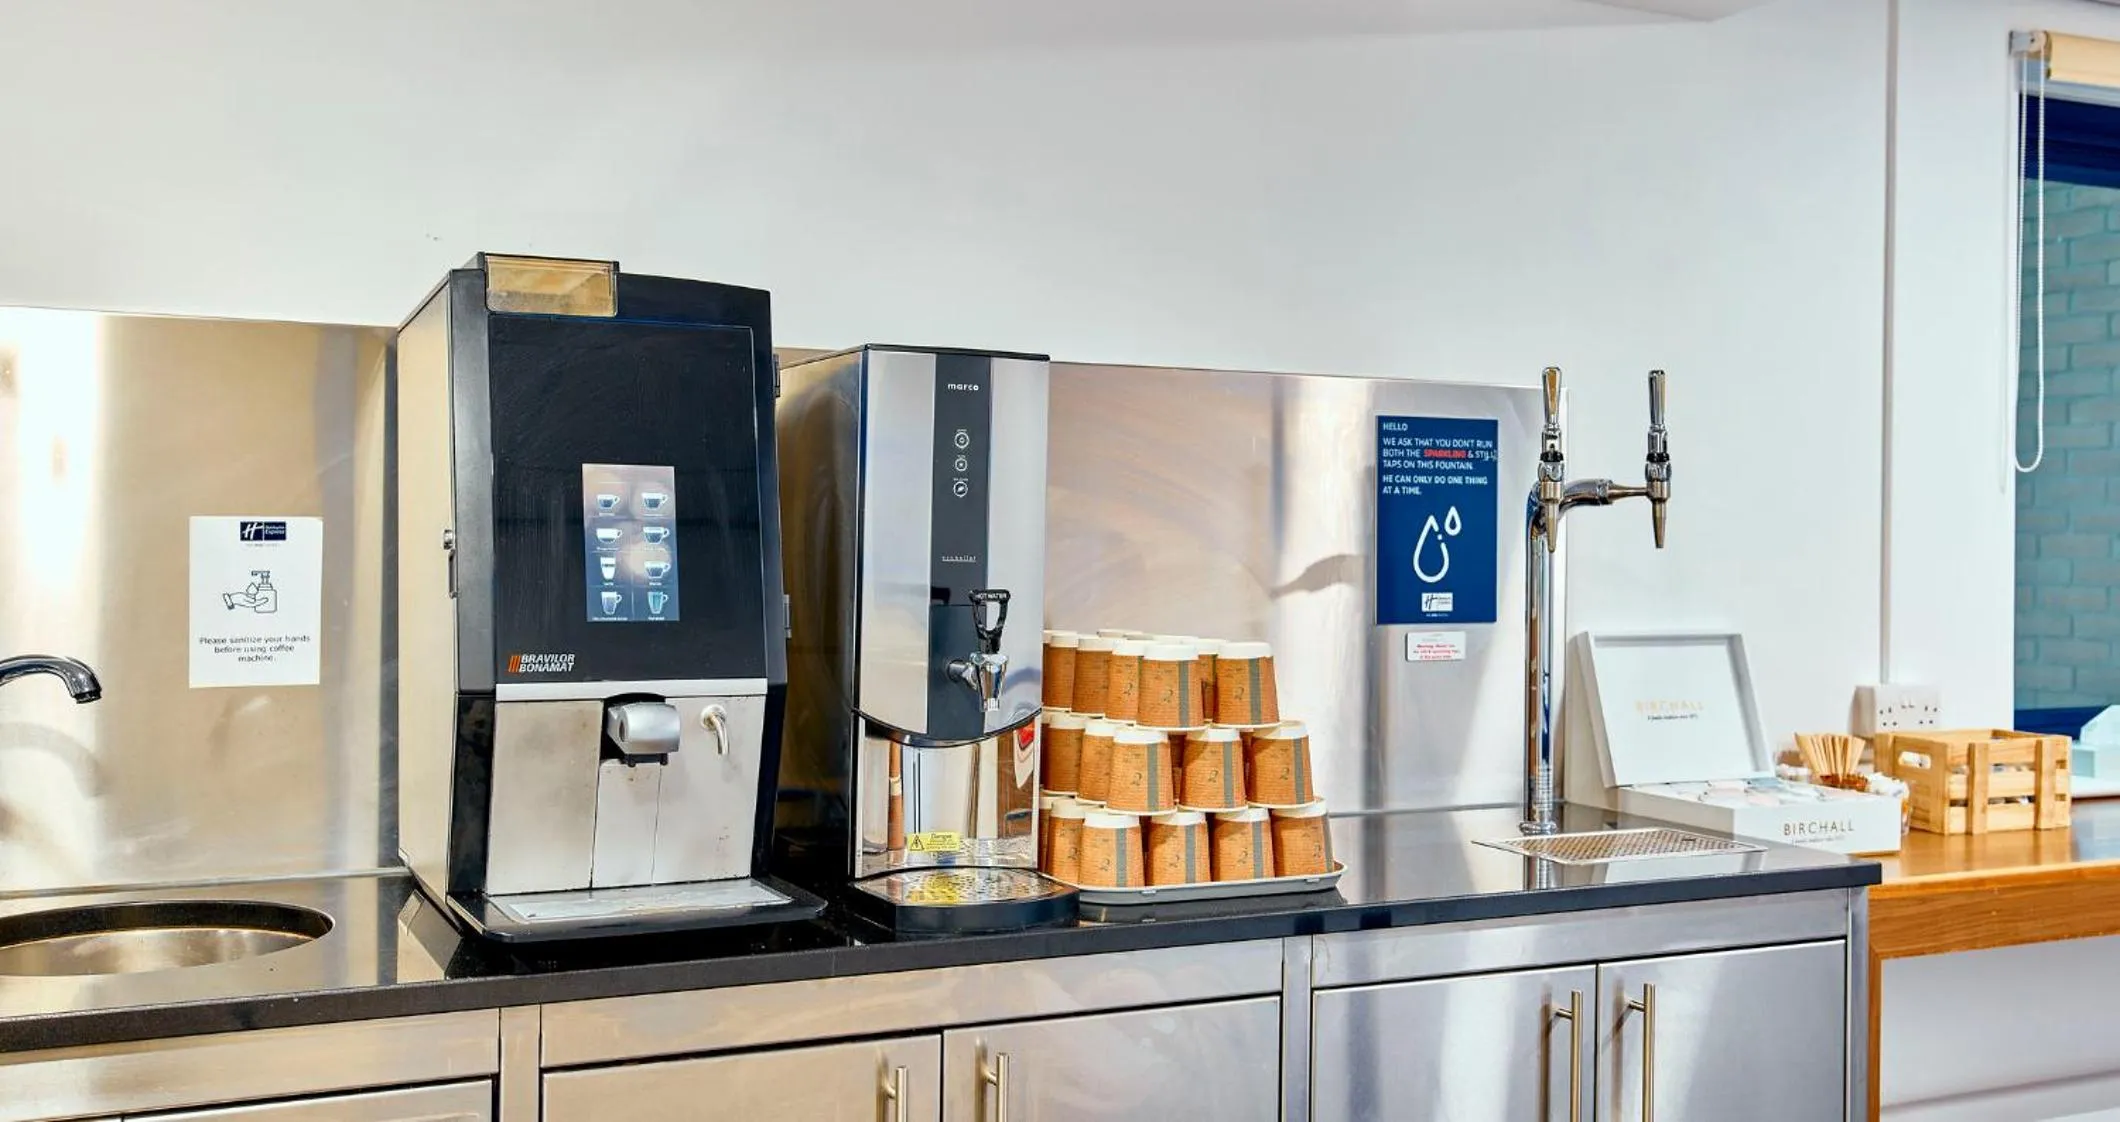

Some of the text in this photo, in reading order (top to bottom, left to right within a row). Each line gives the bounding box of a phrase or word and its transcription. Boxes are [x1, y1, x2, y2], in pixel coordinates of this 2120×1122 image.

[947, 382, 979, 391] marco
[1383, 423, 1408, 431] HELLO
[1383, 437, 1493, 448] WE ASK THAT YOU DON'T RUN
[1383, 449, 1404, 457] BOTH
[1407, 449, 1421, 457] THE
[1423, 449, 1466, 458] SPARKLING
[1467, 450, 1473, 458] &
[1383, 460, 1401, 468] TAPS
[1403, 460, 1415, 468] ON
[1417, 461, 1434, 469] THIS
[1383, 474, 1488, 485] HE CAN ONLY DO ONE THING
[1382, 486, 1393, 494] AT
[1393, 486, 1400, 494] A
[199, 636, 227, 645] Please
[264, 636, 282, 645] your
[285, 635, 311, 643] hands
[214, 645, 241, 654] before
[269, 643, 295, 653] coffee
[521, 653, 575, 664] BRAVILOR
[519, 662, 574, 672] BONAMAT
[1784, 819, 1855, 836] BIRCHALL
